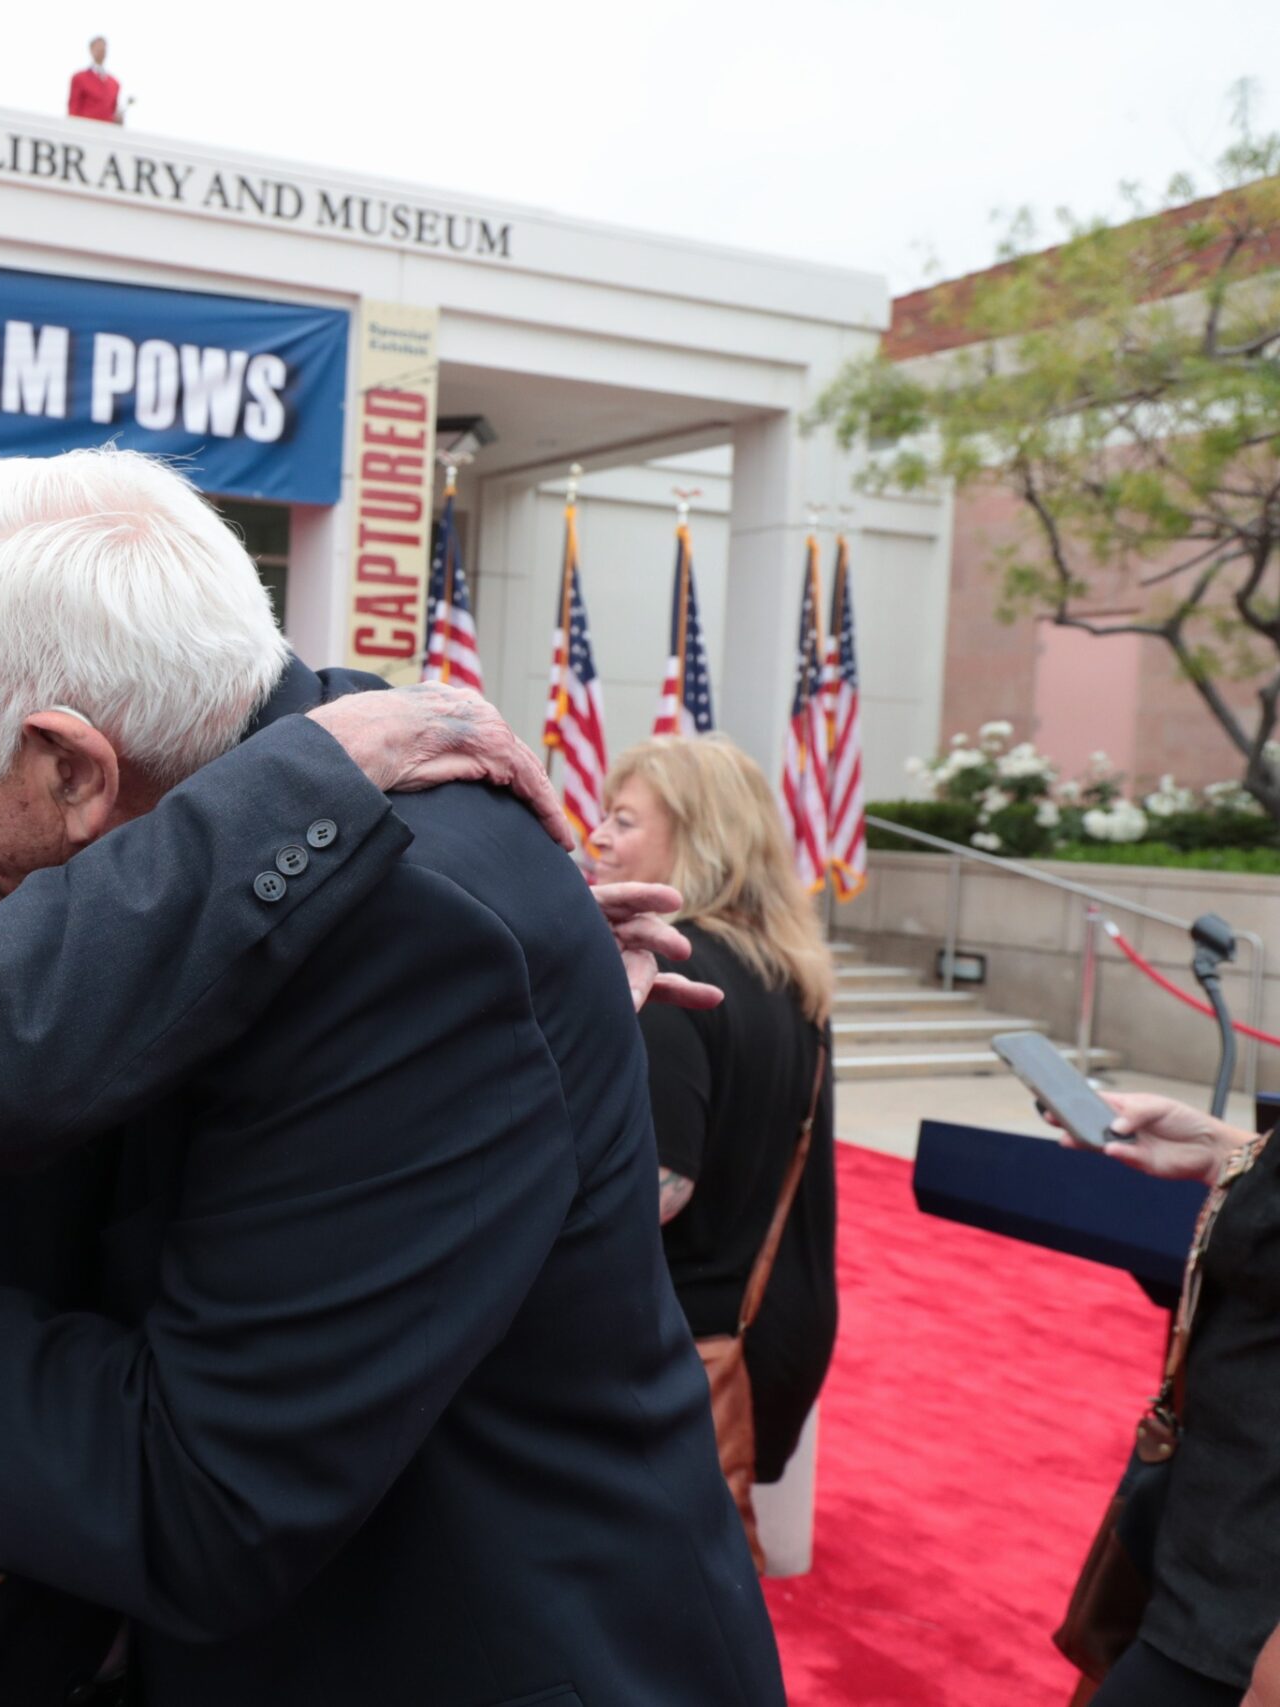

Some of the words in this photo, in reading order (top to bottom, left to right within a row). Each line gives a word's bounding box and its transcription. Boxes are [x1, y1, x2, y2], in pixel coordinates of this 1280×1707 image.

[203, 171, 304, 221] AND
[316, 192, 515, 260] MUSEUM
[91, 331, 288, 444] POWS
[354, 386, 430, 660] CAPTURED
